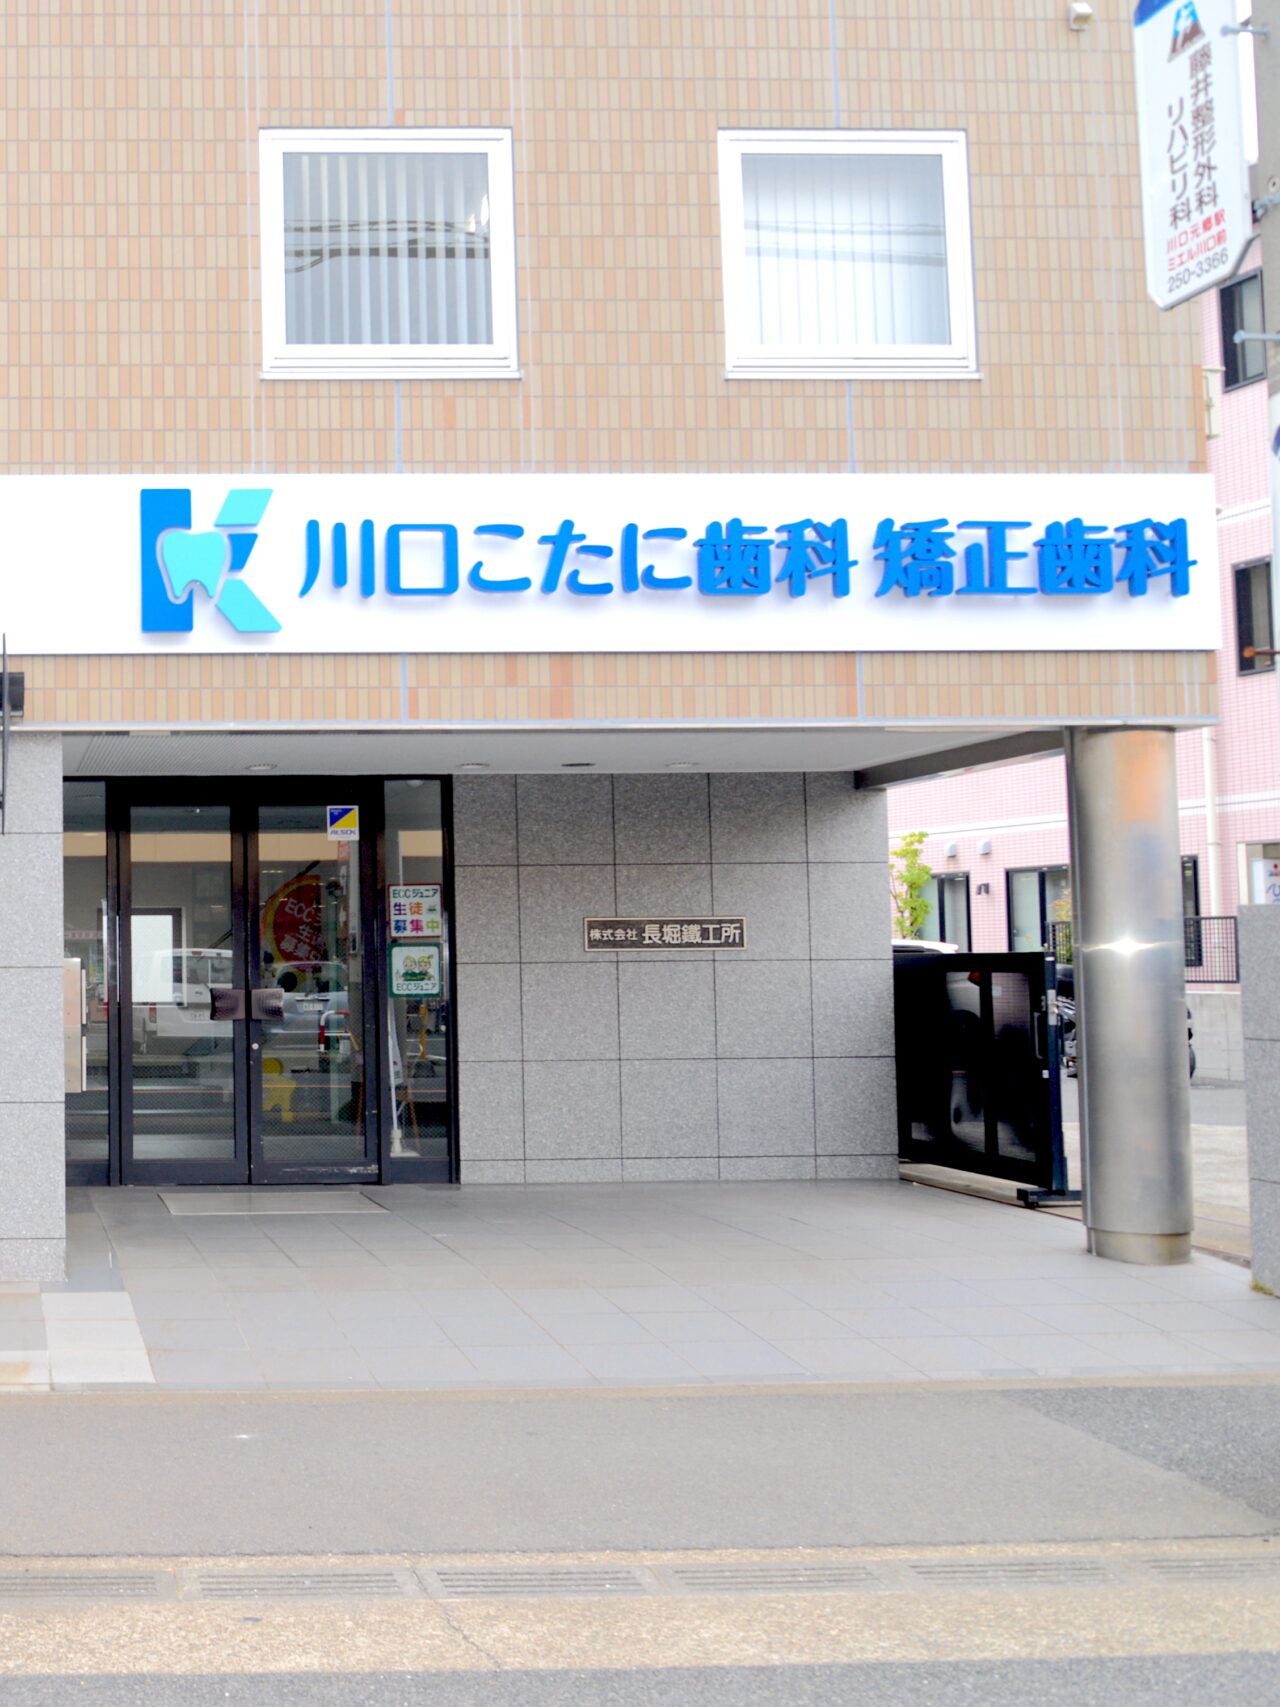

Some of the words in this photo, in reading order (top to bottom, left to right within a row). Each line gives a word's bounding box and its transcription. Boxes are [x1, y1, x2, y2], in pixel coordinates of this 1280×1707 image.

[1167, 97, 1192, 230] リハビリ科
[1167, 247, 1229, 293] 250-3366
[392, 888, 438, 898] ECCジュニア
[393, 902, 424, 915] 生徒
[393, 919, 439, 934] 募集中
[589, 928, 638, 941] 株式会社
